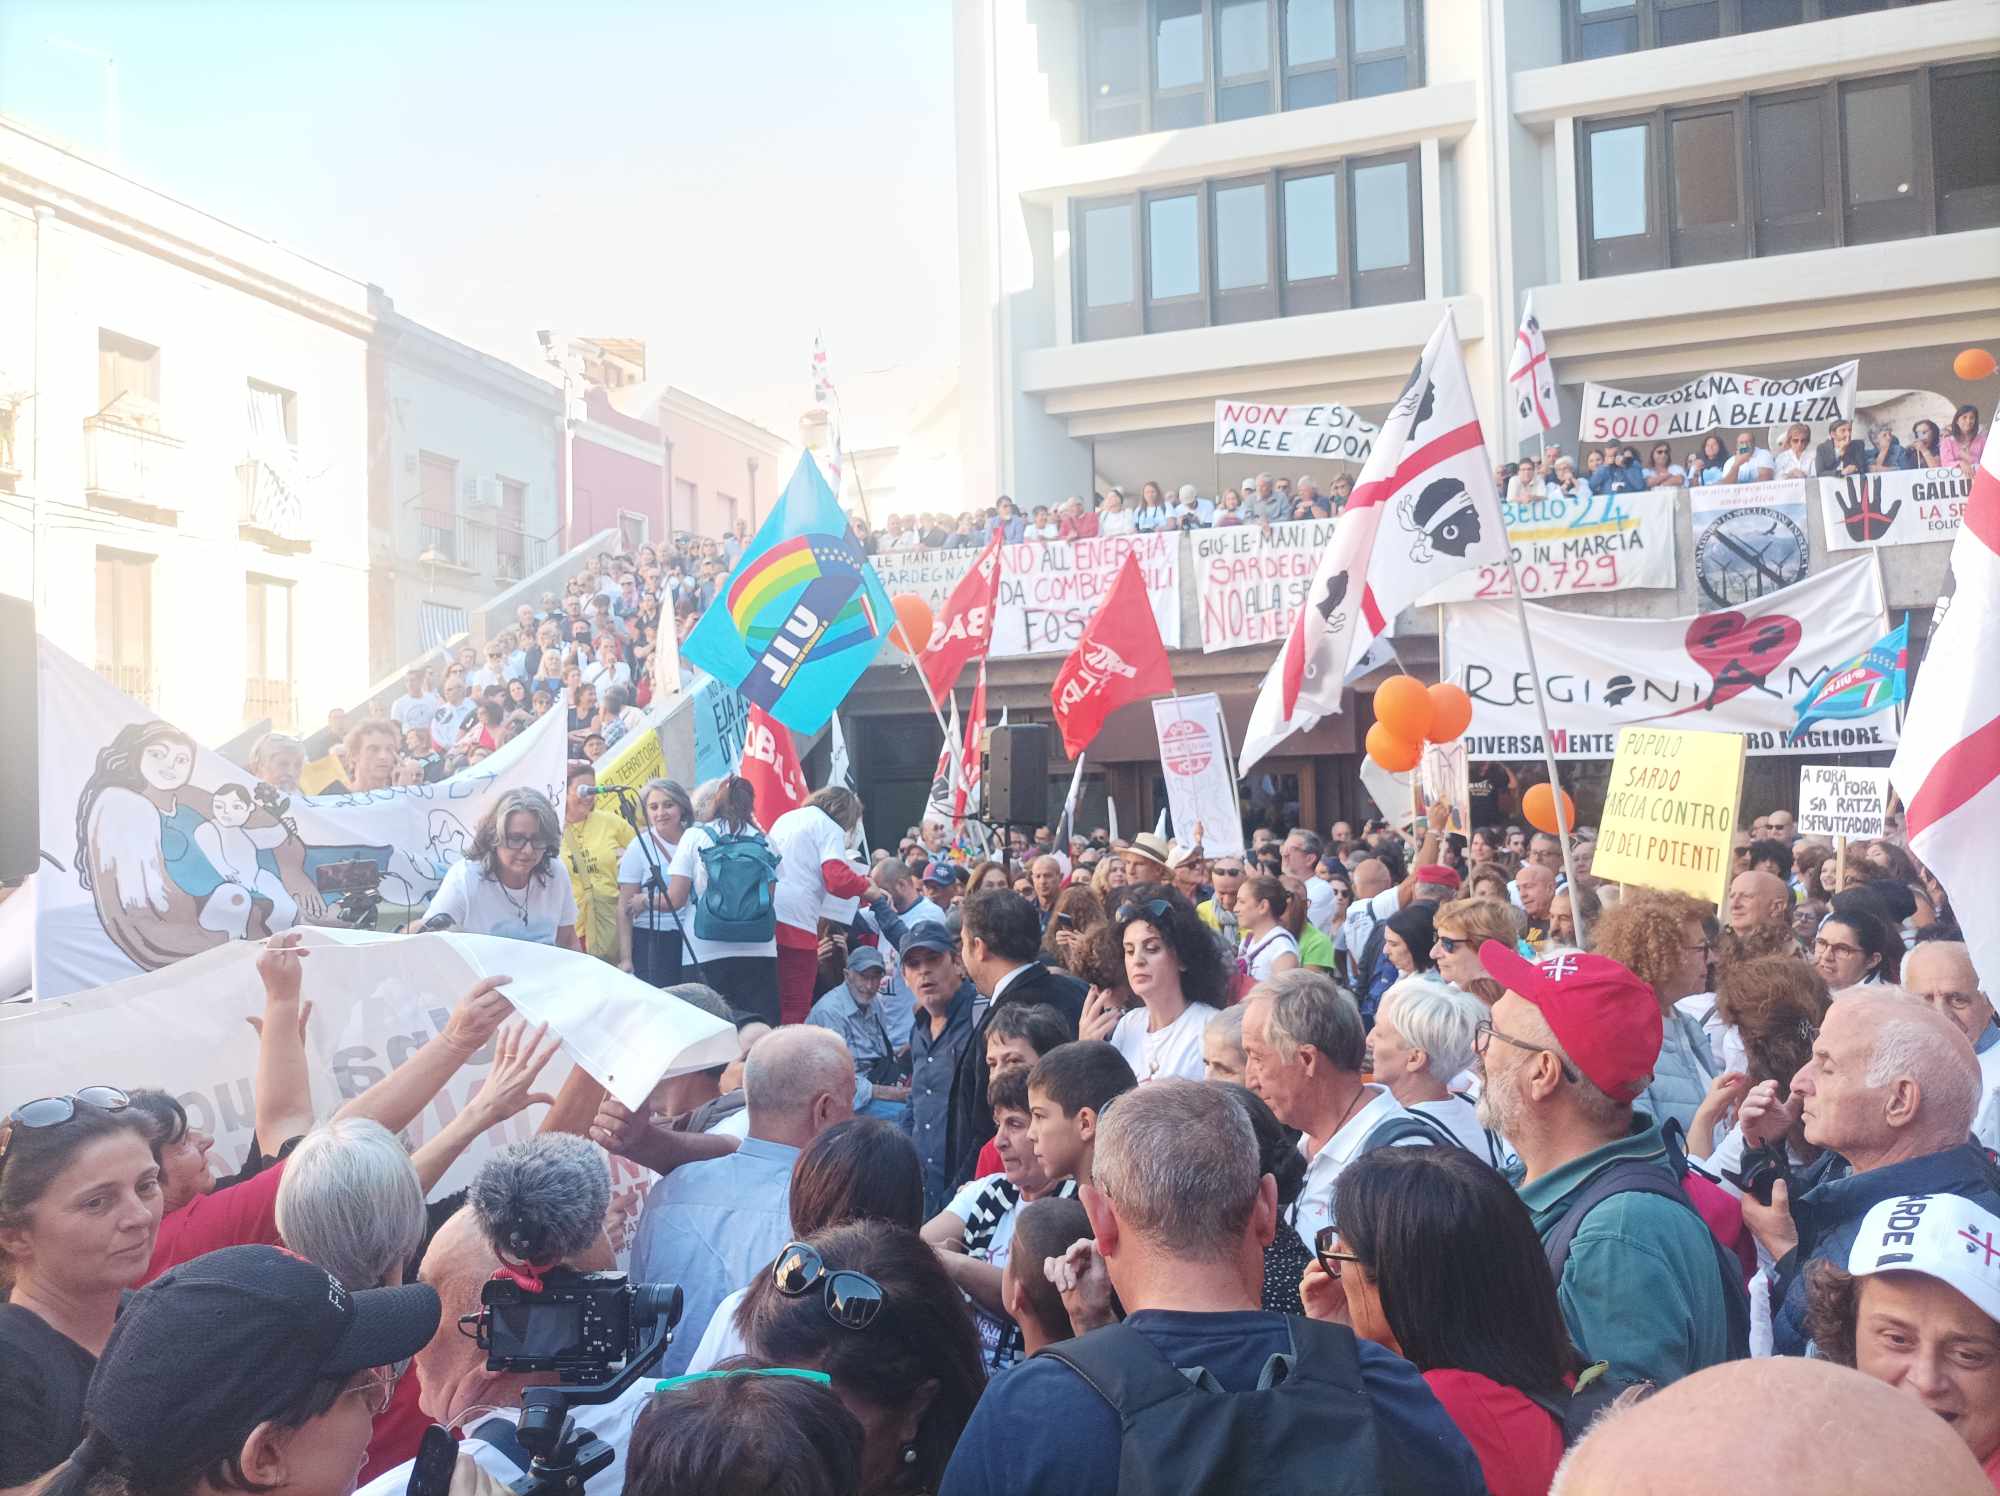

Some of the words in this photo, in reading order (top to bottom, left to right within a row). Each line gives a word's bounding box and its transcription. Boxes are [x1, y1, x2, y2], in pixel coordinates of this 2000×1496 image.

[1761, 370, 1844, 396] IDONEA
[1224, 404, 1288, 425] NON
[1593, 413, 1659, 438] SOLO
[1668, 406, 1721, 435] ALLA
[1730, 397, 1842, 426] BELLEZZA
[1221, 428, 1293, 452] AREE
[1920, 505, 1942, 520] LA
[1000, 580, 1026, 606] DA
[1204, 589, 1243, 644] NO
[1246, 583, 1281, 614] ALLA
[1625, 733, 1683, 758] POPOLO
[1625, 766, 1681, 791] SARDO
[1802, 768, 1810, 783] A
[1816, 768, 1847, 783] FORA
[1830, 782, 1839, 796] A
[1844, 780, 1877, 796] FORA
[1650, 798, 1730, 832] CONTRO
[1809, 797, 1827, 812] SA
[1836, 797, 1882, 813] RATZA
[1617, 832, 1642, 857] DEI
[1646, 836, 1721, 873] POTENTI
